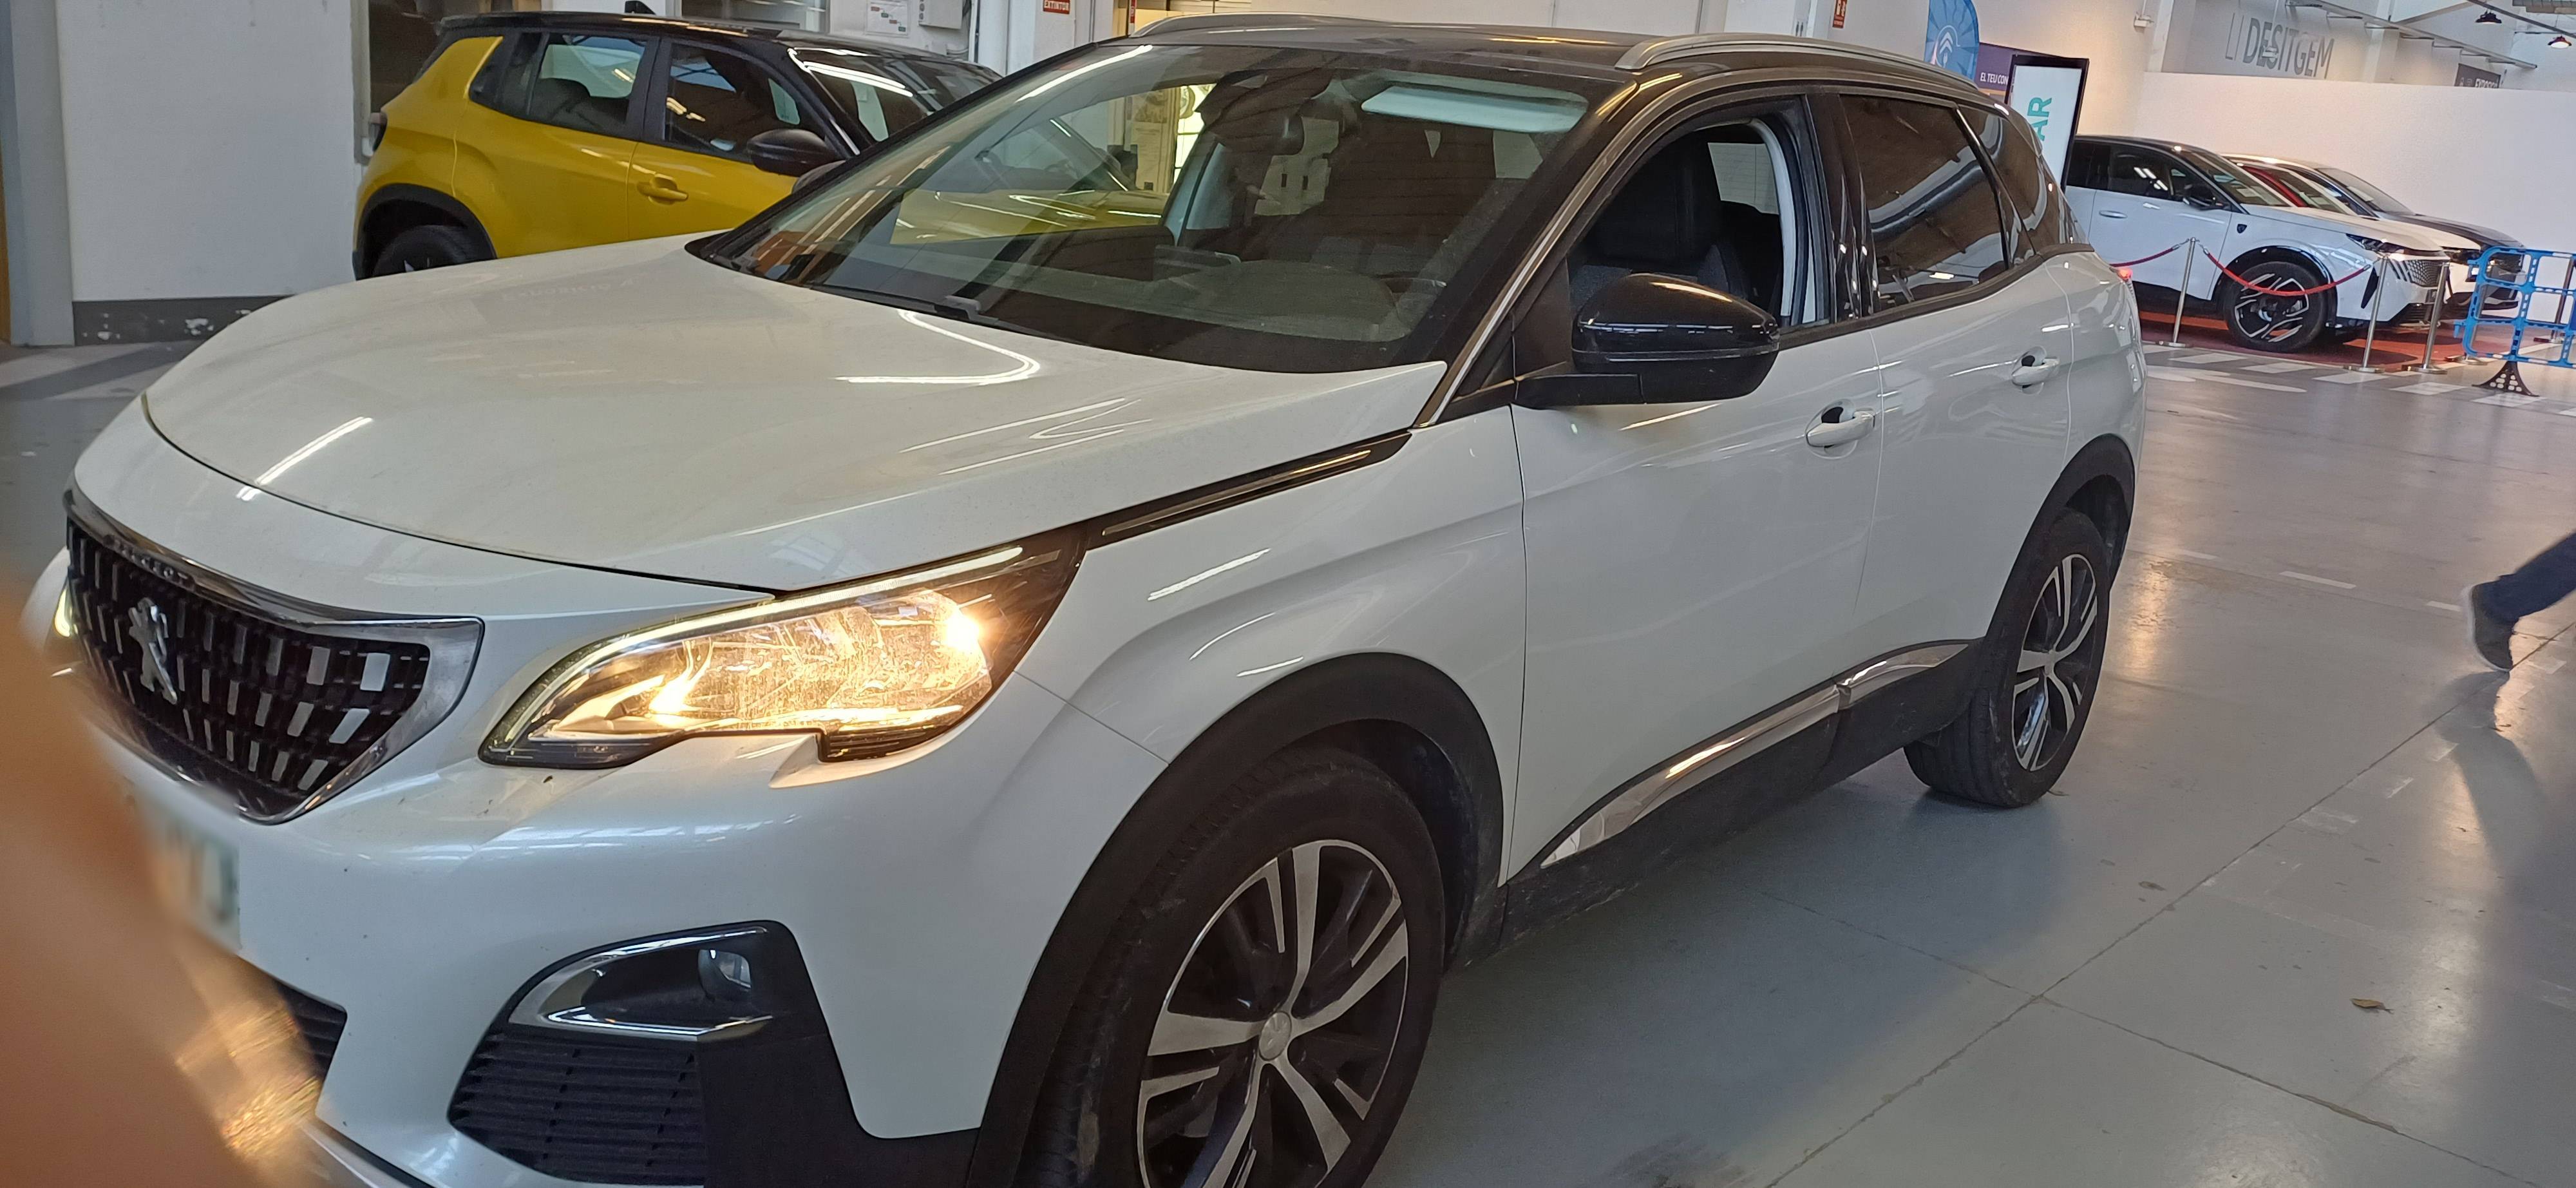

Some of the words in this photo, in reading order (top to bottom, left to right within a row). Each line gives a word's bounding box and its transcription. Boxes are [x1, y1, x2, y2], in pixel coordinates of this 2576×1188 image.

[2242, 17, 2334, 79] DESITGEM
[1980, 72, 1986, 82] EL
[1987, 73, 1998, 83] TEU
